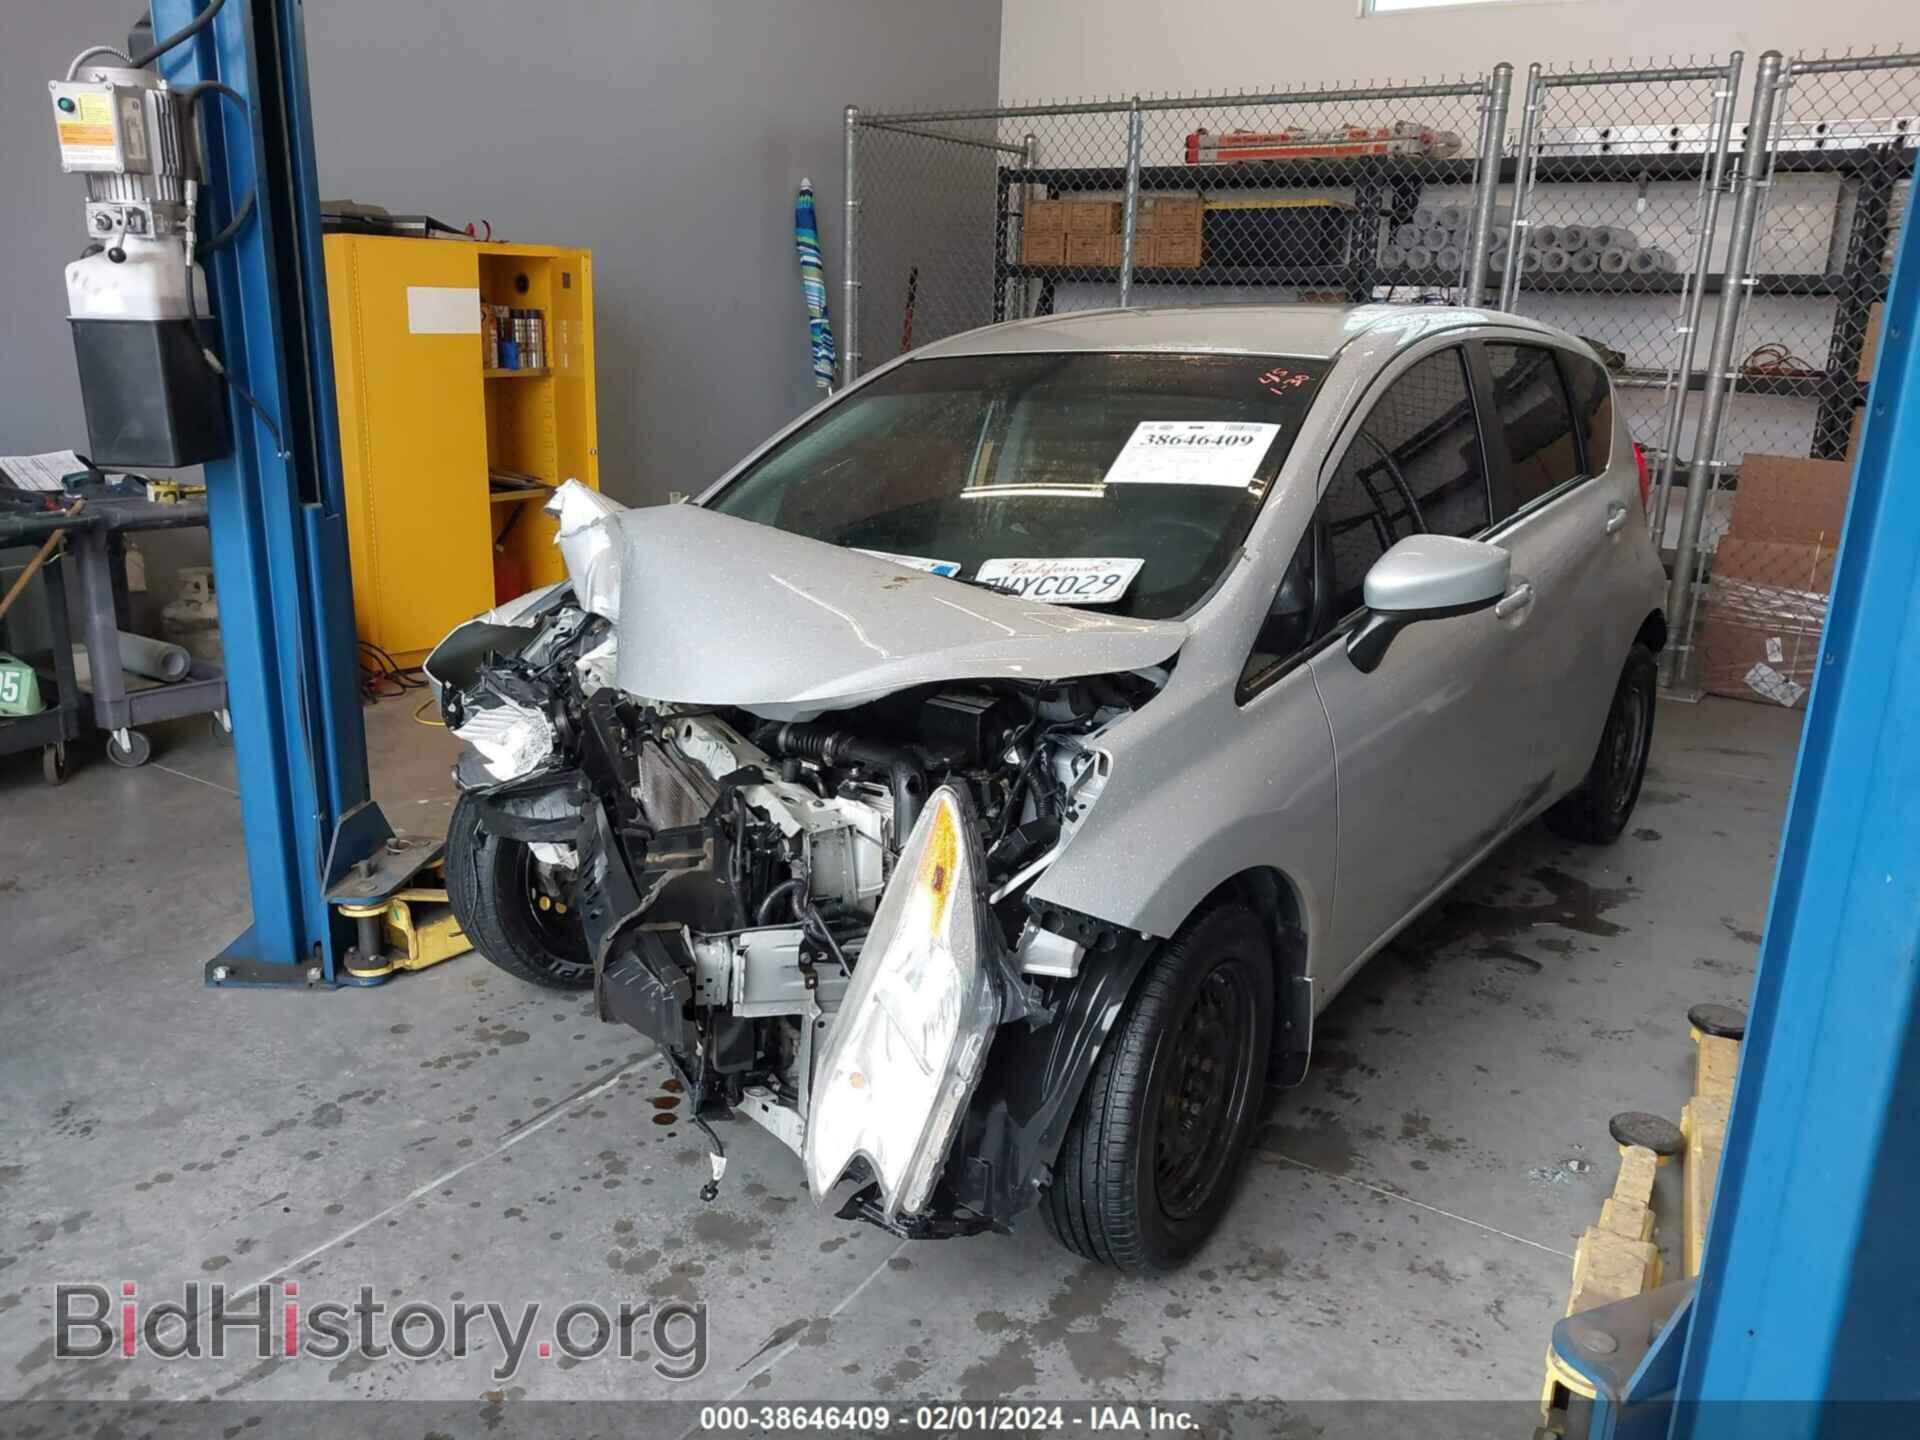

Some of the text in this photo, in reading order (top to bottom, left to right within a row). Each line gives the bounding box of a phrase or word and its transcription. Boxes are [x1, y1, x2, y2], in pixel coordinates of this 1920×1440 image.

[1139, 433, 1254, 447] 38646409
[1009, 560, 1106, 577] California
[0, 671, 20, 702] 5
